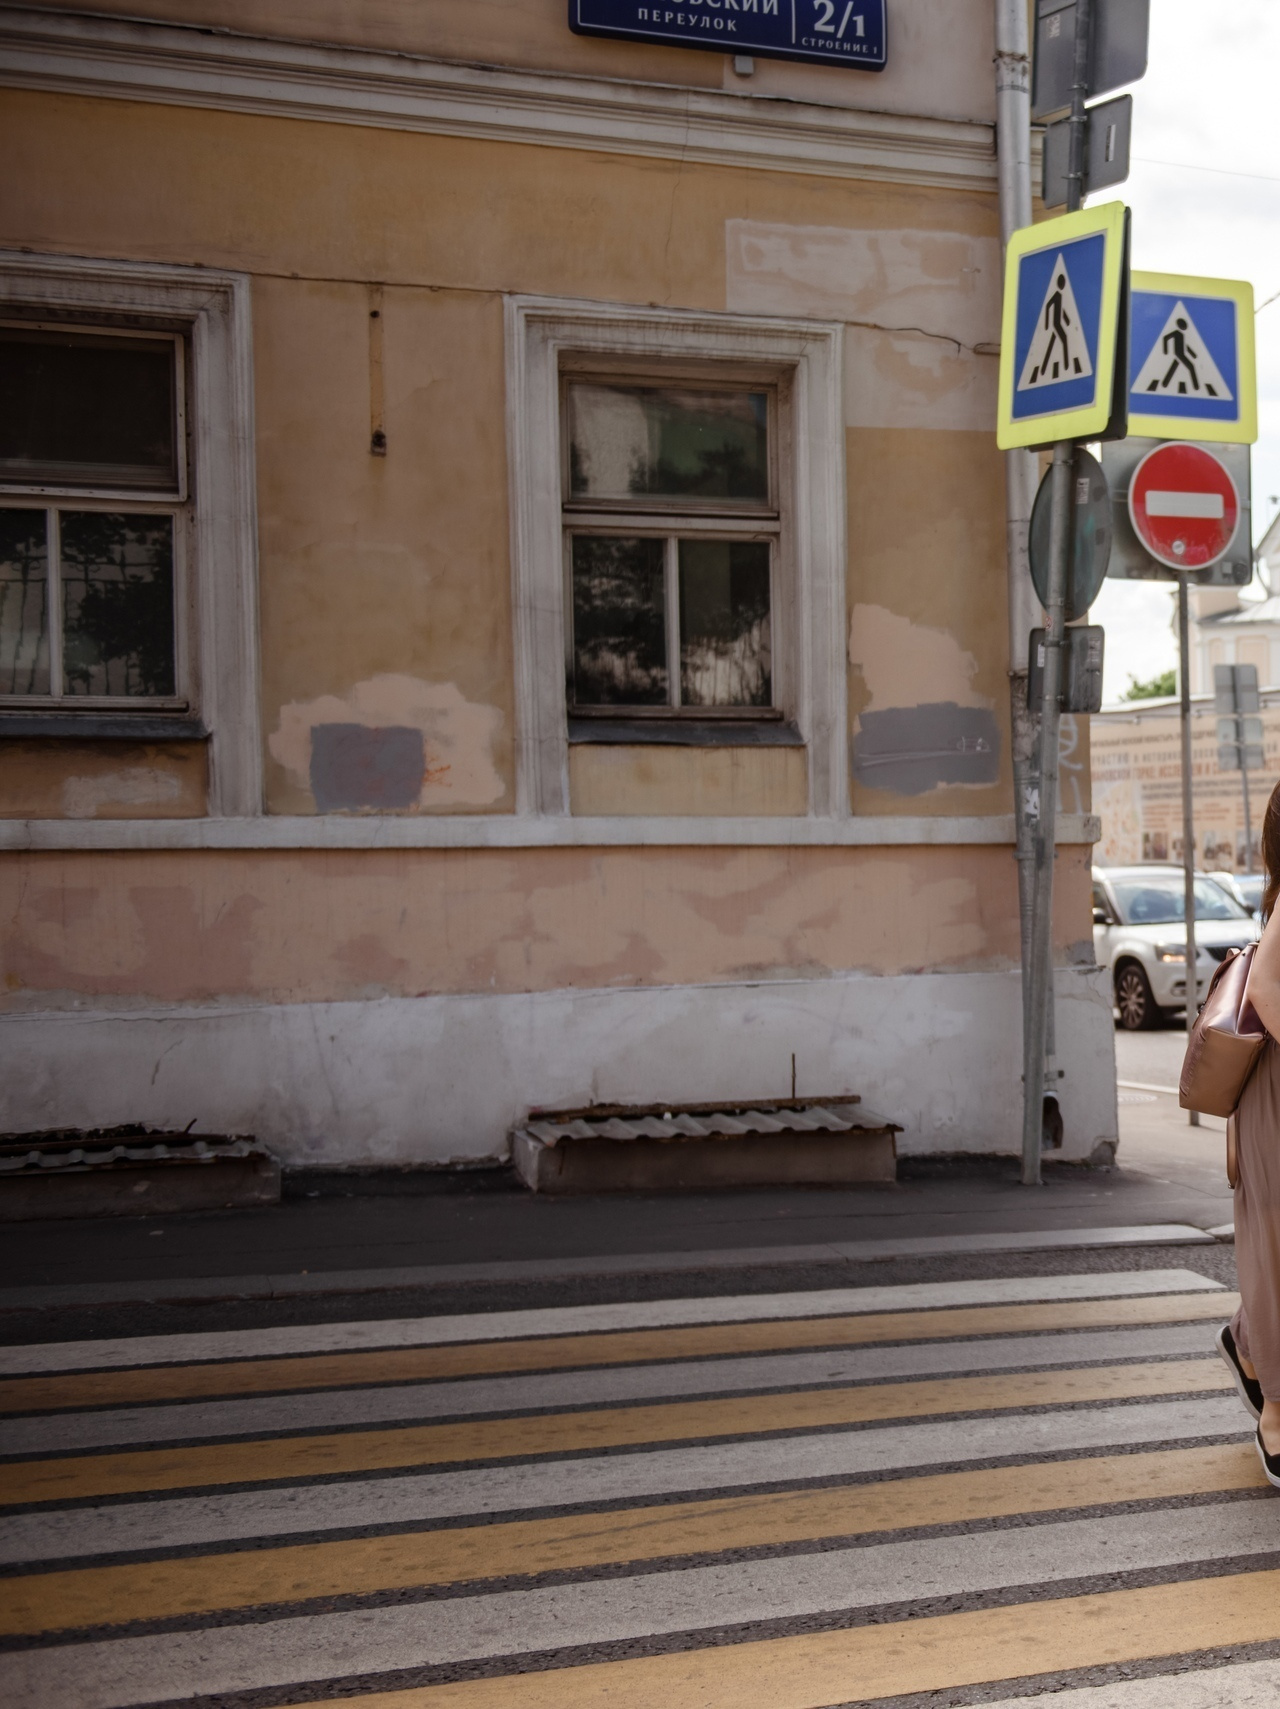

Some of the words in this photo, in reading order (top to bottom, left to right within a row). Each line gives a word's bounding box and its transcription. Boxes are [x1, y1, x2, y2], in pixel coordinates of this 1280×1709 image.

[637, 8, 737, 32] ПЕРЕУЛОК
[813, 0, 866, 39] 2/1
[801, 36, 869, 54] СТРОЕНИЕ
[872, 46, 878, 55] 1
